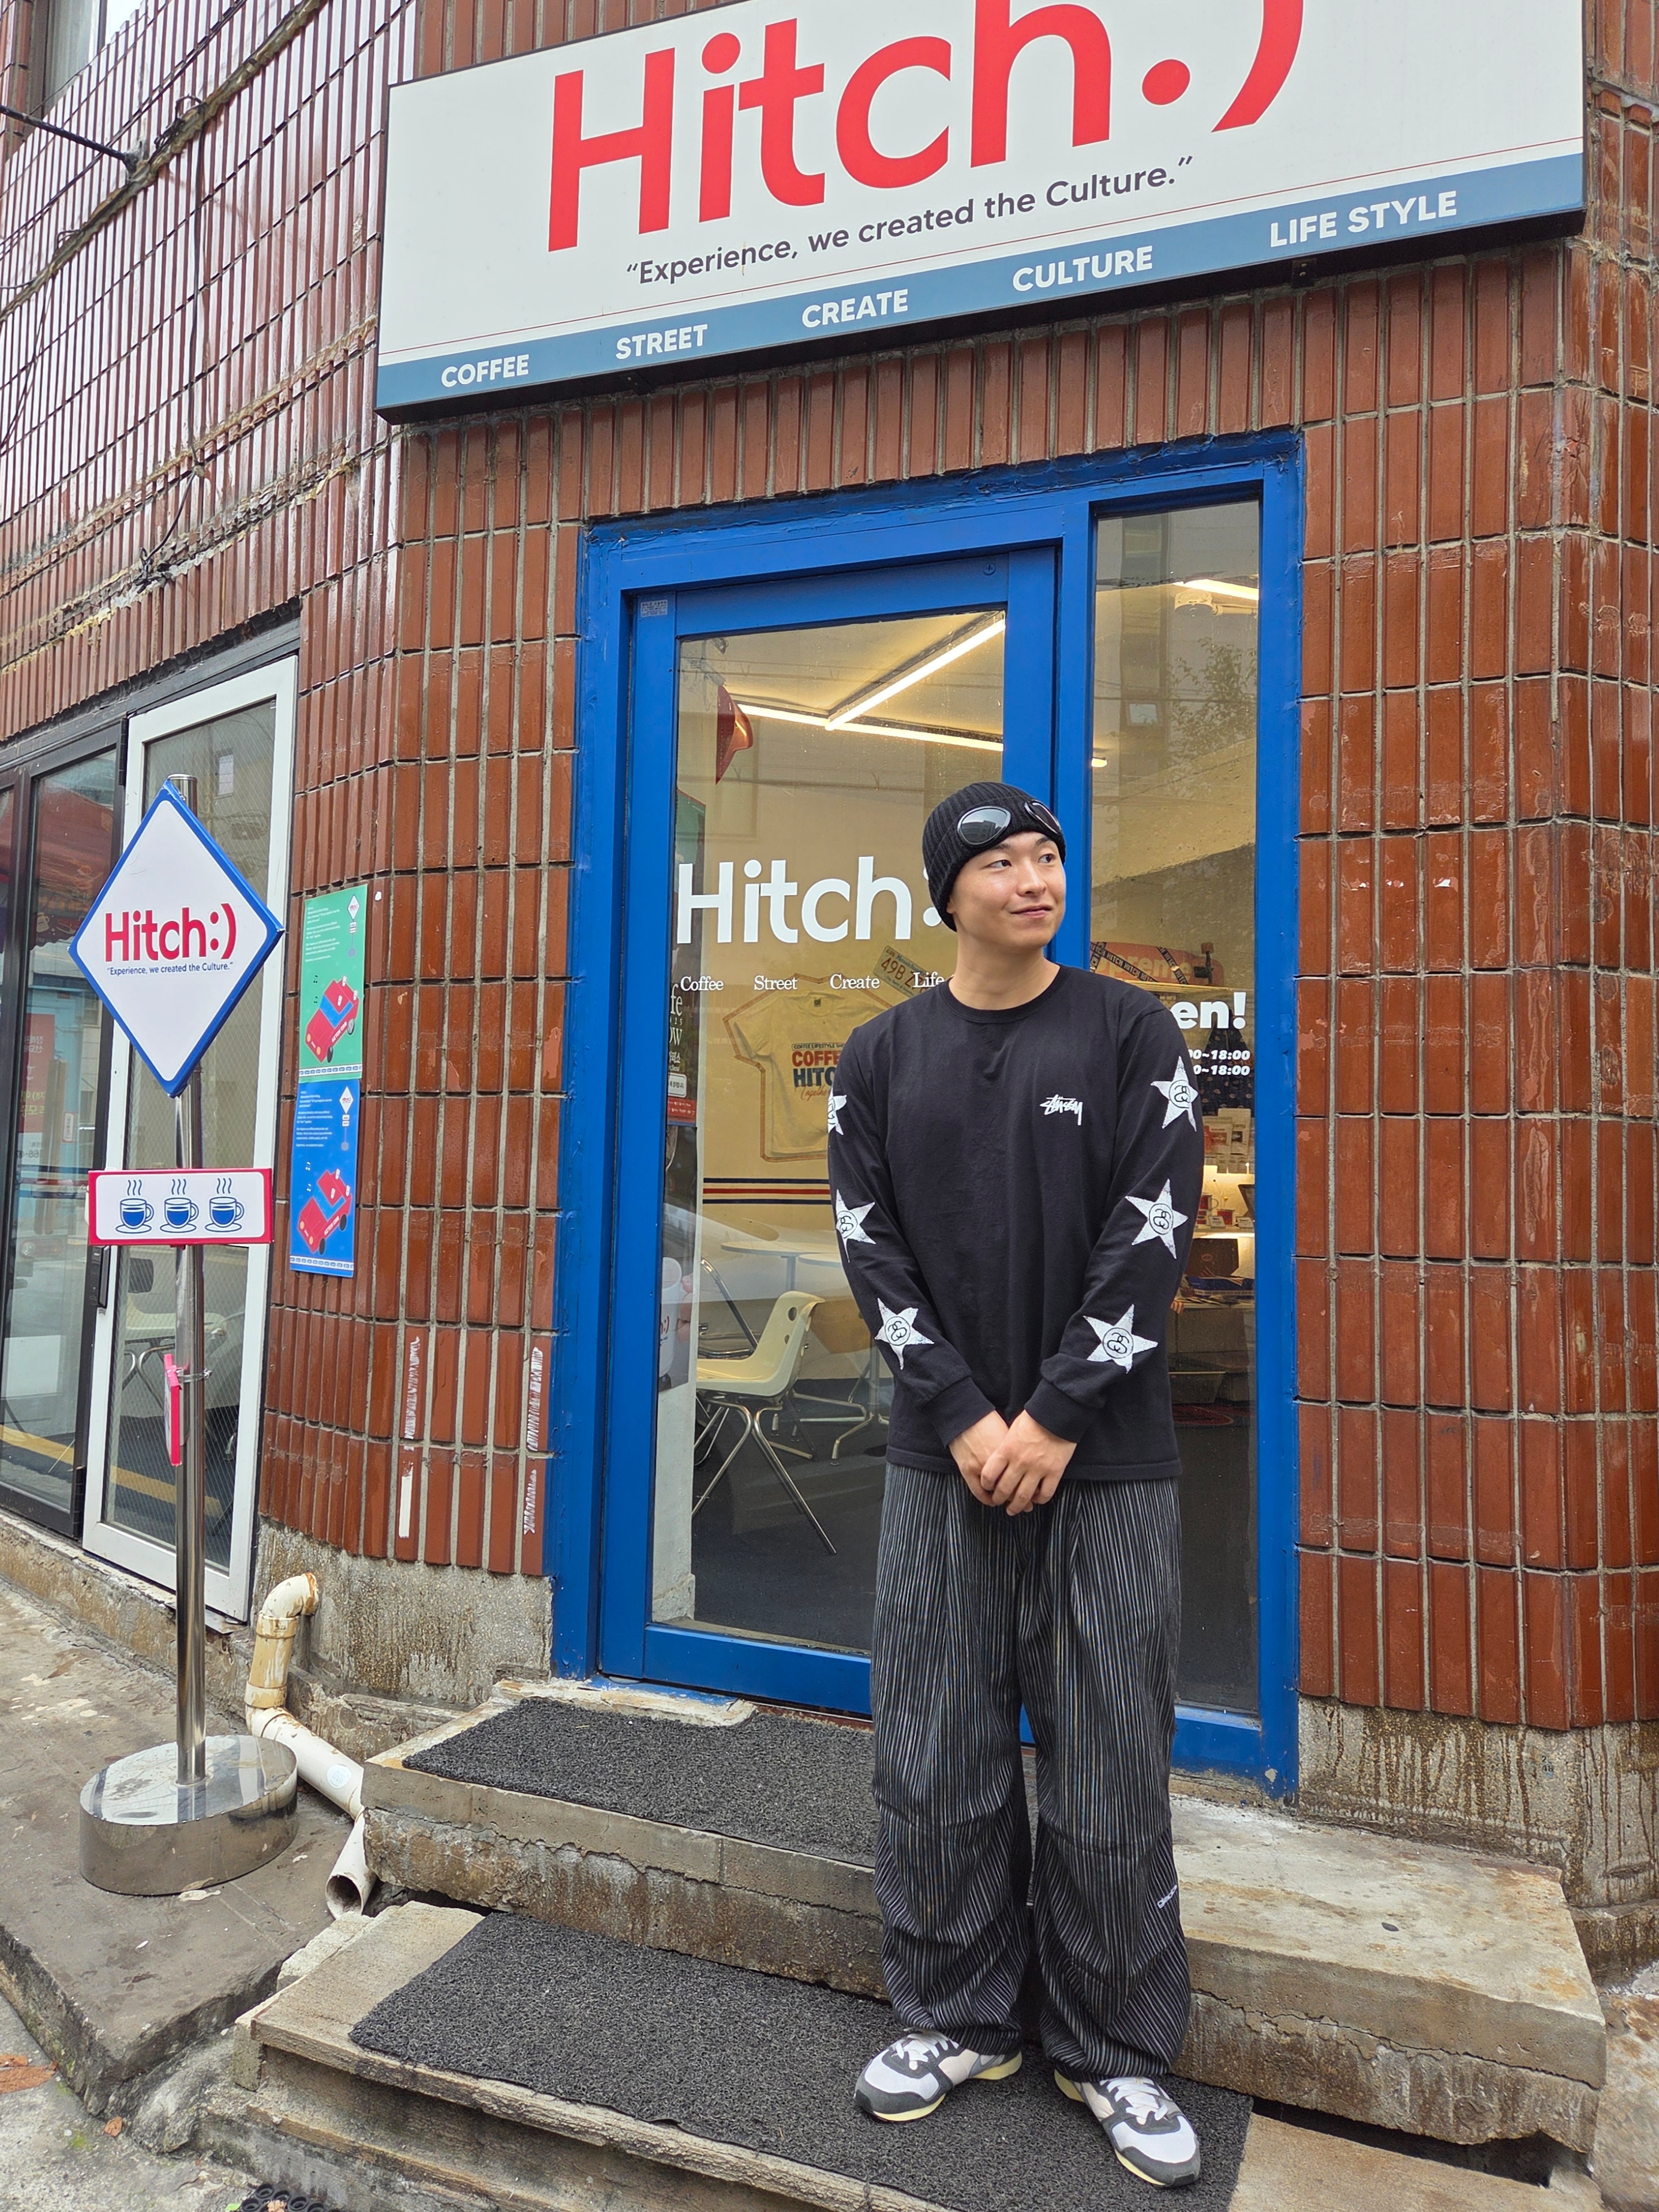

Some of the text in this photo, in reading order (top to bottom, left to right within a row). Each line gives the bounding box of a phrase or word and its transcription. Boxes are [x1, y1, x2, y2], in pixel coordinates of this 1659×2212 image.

[808, 228, 849, 252] we
[858, 198, 974, 244] created
[984, 186, 1036, 218] the
[441, 191, 1457, 388] COFFEE STREET CREATE CULTURE LIFE STYLE
[105, 903, 237, 962] Hitch:)
[161, 963, 187, 973] created
[189, 963, 200, 972] the
[681, 971, 945, 992] Coffee Street Create Life
